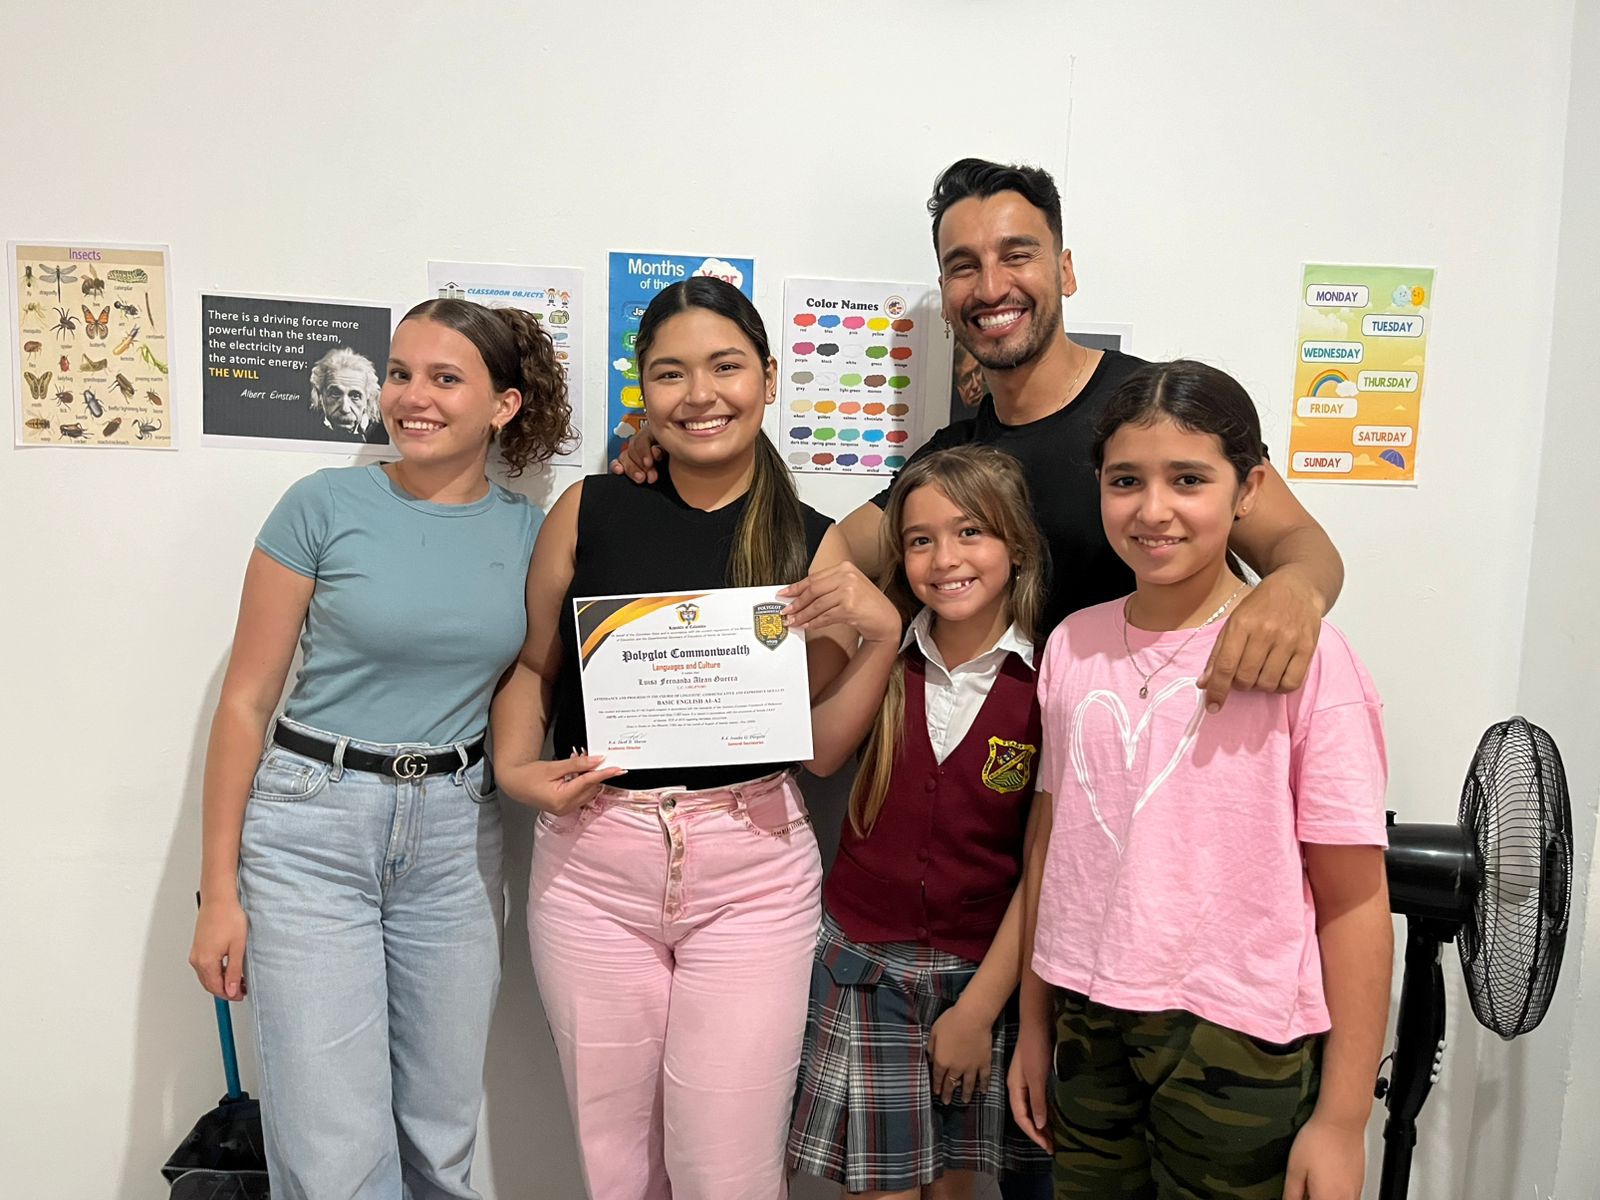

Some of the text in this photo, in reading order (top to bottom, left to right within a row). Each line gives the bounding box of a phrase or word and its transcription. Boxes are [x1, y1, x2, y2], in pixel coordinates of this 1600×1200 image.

[70, 248, 101, 261] Insects
[628, 258, 685, 277] Months
[702, 270, 737, 283] Yar
[640, 278, 671, 290] of the
[467, 288, 544, 299] CLASSROOM OBJECTS
[1316, 291, 1359, 302] MONDAY
[806, 298, 879, 311] Color Names
[208, 310, 359, 330] There is a driving force more
[1372, 321, 1413, 332] TUESDAY
[208, 325, 342, 344] powerful than the steam,
[209, 339, 304, 354] the electricity and
[1304, 347, 1360, 359] WEDNESDAY
[209, 354, 308, 370] the atomic energy:
[208, 367, 259, 380] THE WILL
[1364, 377, 1411, 388] THURSDAY
[240, 389, 300, 401] Albert Einstein
[1310, 403, 1344, 414] FRIDAY
[1358, 431, 1407, 442] SATURDAY
[1304, 457, 1341, 468] SUNDAY
[622, 645, 750, 663] Polyglot Commonwealth
[652, 663, 684, 672] Languages
[698, 661, 721, 669] Culture
